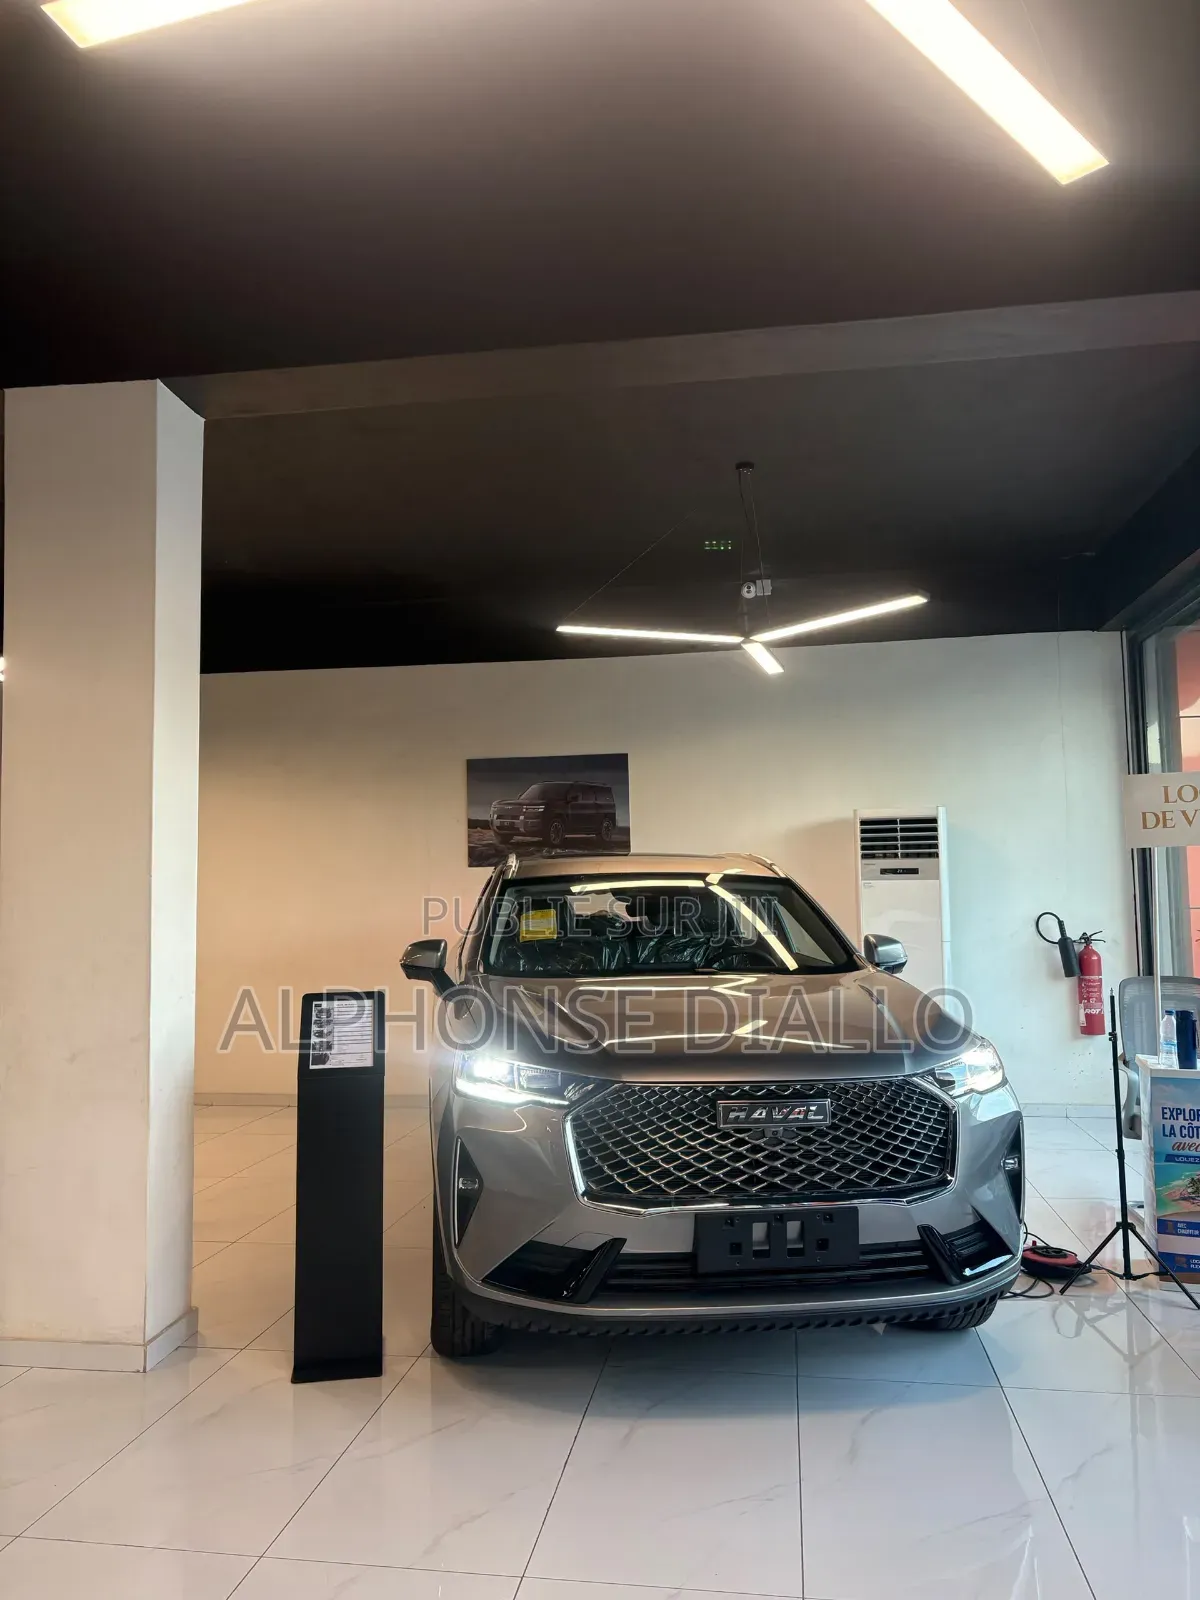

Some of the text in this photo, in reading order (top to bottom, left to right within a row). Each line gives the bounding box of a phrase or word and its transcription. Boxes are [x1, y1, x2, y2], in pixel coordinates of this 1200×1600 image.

[1162, 784, 1200, 804] LO
[1141, 810, 1176, 829] DE
[727, 1105, 824, 1122] HAVAL
[1162, 1123, 1177, 1138] LA
